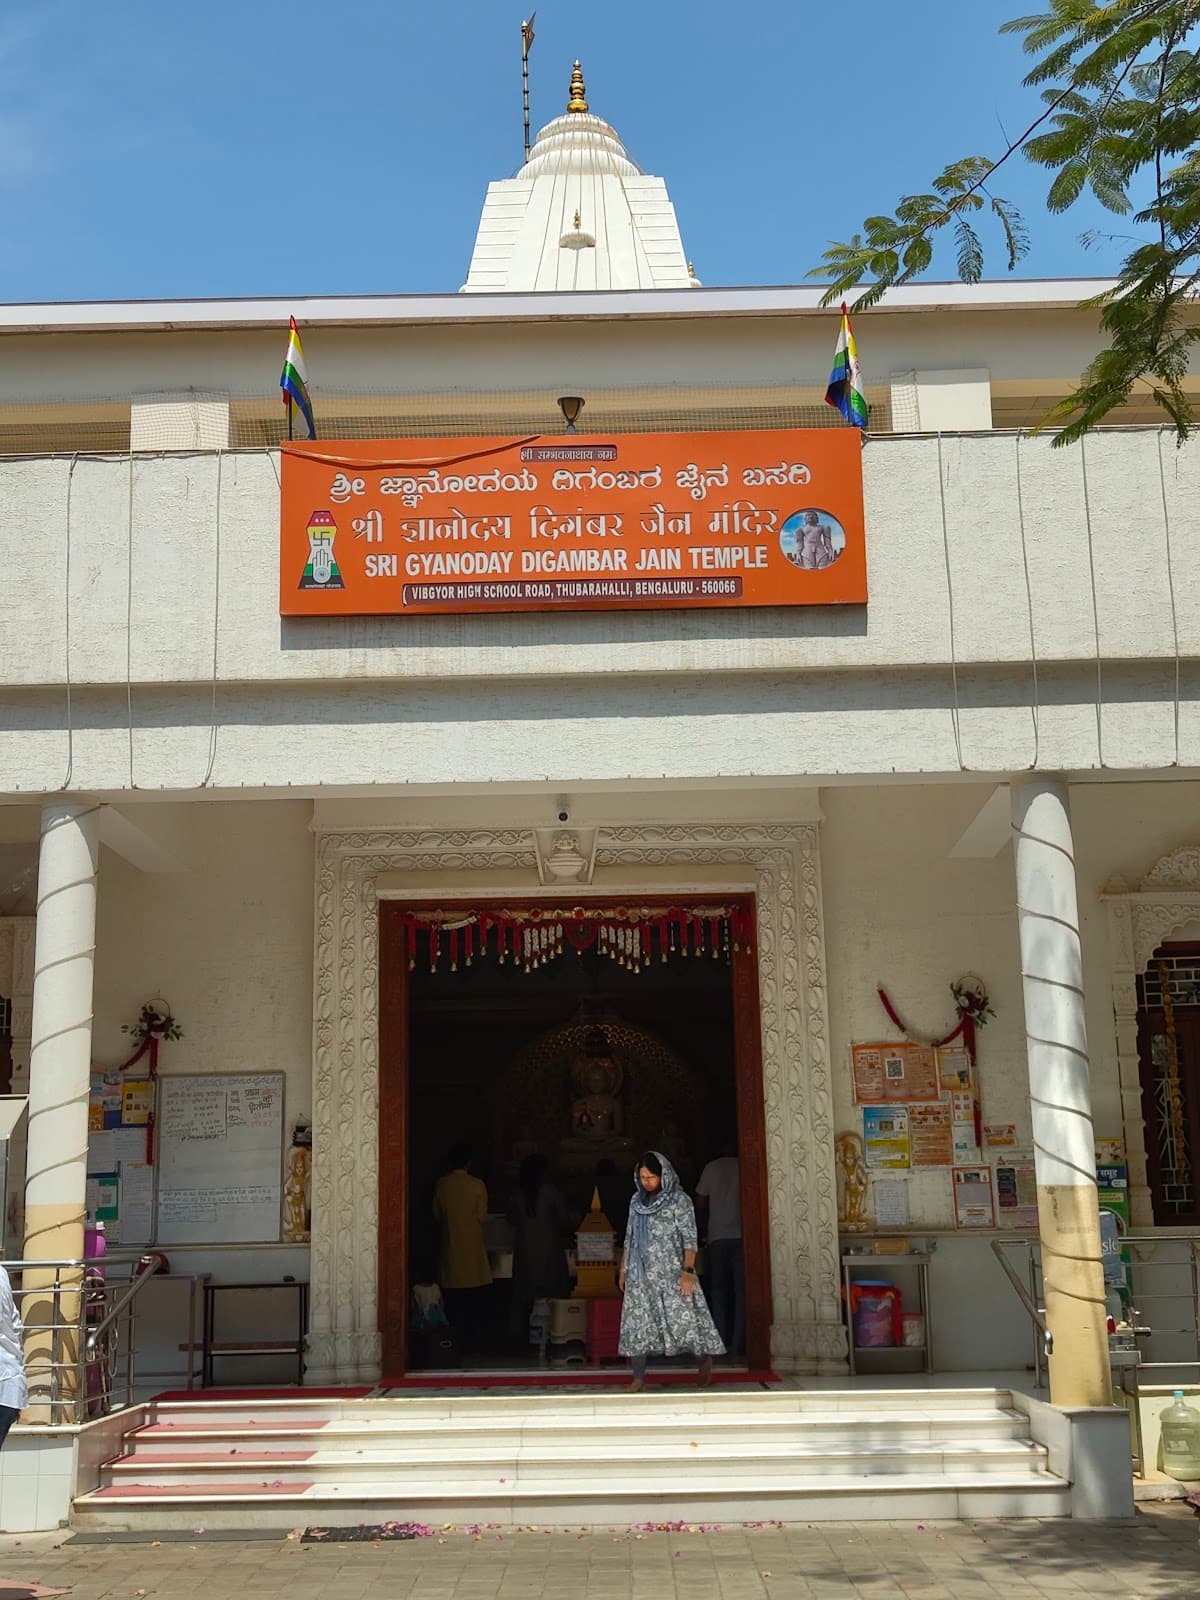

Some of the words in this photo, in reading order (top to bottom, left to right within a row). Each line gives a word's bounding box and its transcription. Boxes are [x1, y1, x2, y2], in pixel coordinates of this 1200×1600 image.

[329, 472, 366, 504] ಶ್ರೀ
[380, 469, 538, 508] ಜ್ಞಾನೋದಯ
[552, 465, 662, 490] ದಿಗಂಬರ
[676, 462, 729, 500] ಜೈನ
[742, 461, 811, 486] ಬಸದಿ
[351, 509, 383, 543] श्री
[528, 505, 625, 540] दिगंबर
[640, 502, 693, 536] जैन
[707, 500, 780, 535] मंदिर
[365, 554, 398, 577] SRI
[405, 551, 514, 576] GYANODAY
[521, 549, 628, 573] DIGAMBAR
[635, 547, 681, 571] JAIN
[688, 546, 769, 569] TEMPLE
[412, 586, 455, 600] VIBGYOR
[457, 585, 482, 599] HIGH
[484, 584, 522, 599] SCHOOL
[525, 583, 554, 599] ROAD,
[556, 581, 633, 597] THUBARAHALLI,
[635, 581, 693, 595] BENGALURU
[702, 581, 736, 594] 560066
